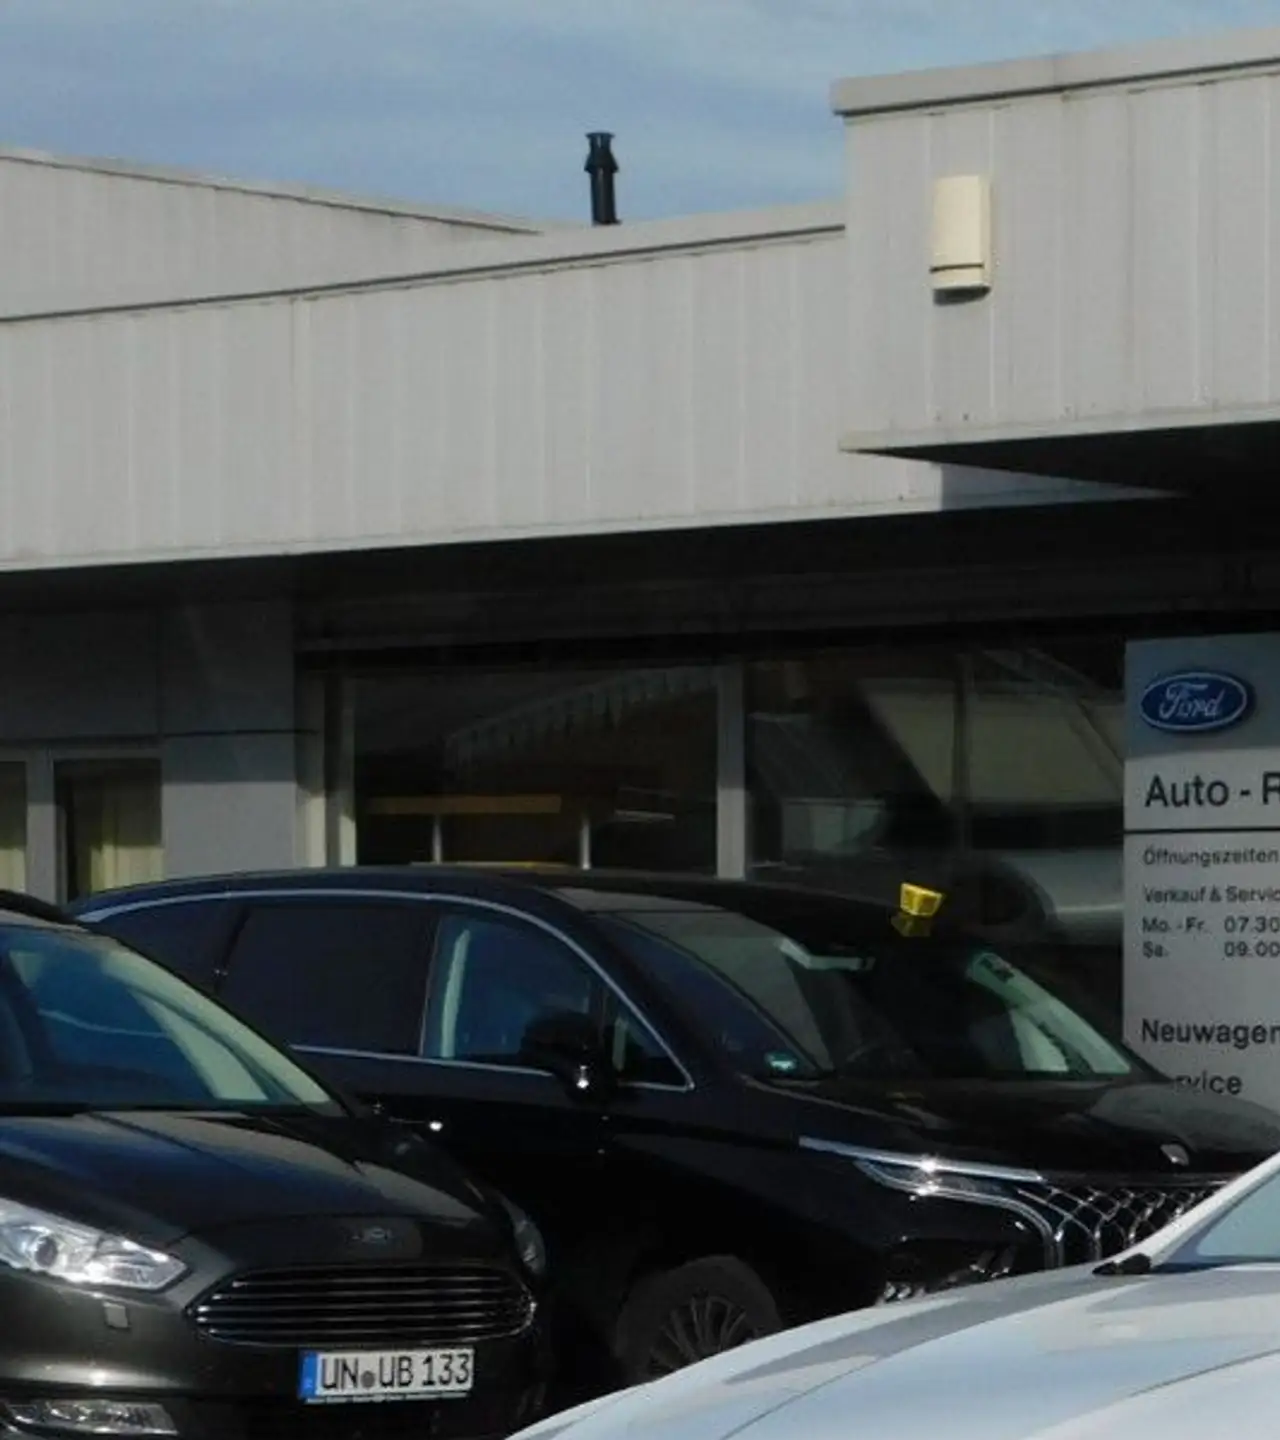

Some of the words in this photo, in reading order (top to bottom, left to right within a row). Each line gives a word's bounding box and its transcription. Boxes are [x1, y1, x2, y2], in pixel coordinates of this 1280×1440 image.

[1158, 681, 1224, 719] Ford
[1144, 774, 1230, 808] Auto
[1143, 845, 1280, 868] Öffnungszeiten
[1144, 886, 1206, 903] Verkauf
[321, 1357, 359, 1390] UN
[379, 1355, 414, 1388] UB
[421, 1353, 470, 1387] 133
